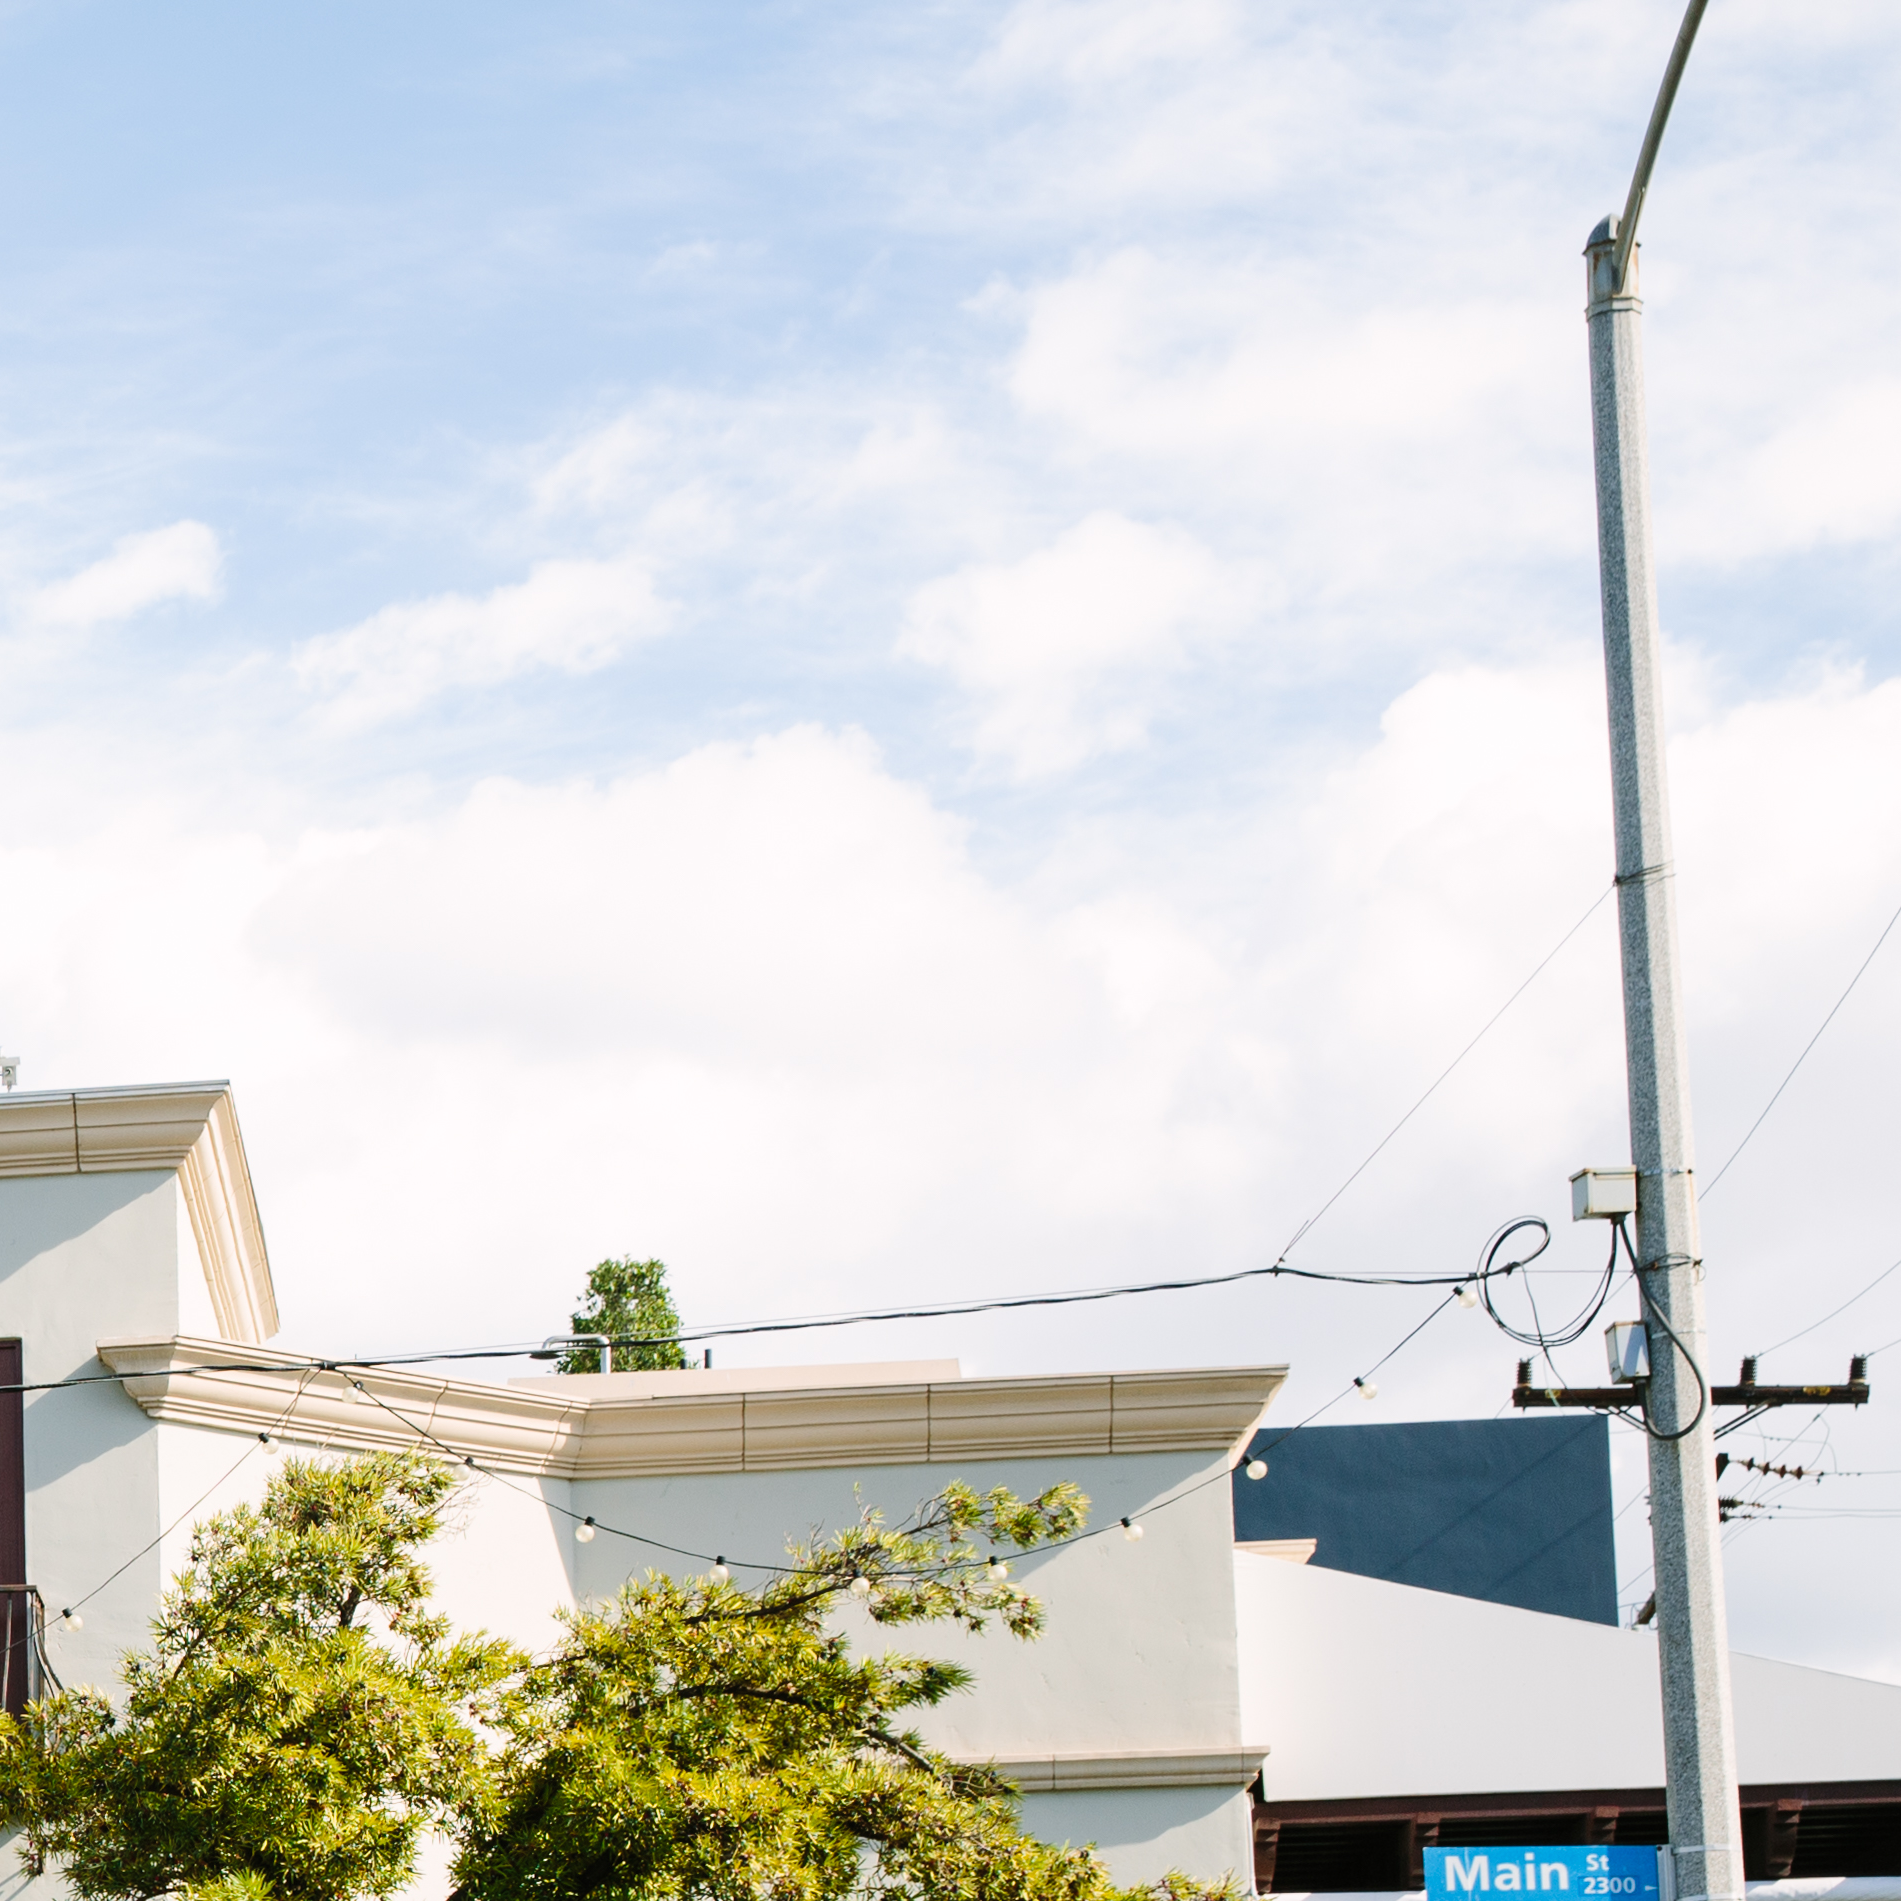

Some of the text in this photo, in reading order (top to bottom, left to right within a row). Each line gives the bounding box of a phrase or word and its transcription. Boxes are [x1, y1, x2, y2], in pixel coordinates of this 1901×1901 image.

[1444, 1852, 1609, 1892] Main St
[1584, 1877, 1636, 1894] 2300
